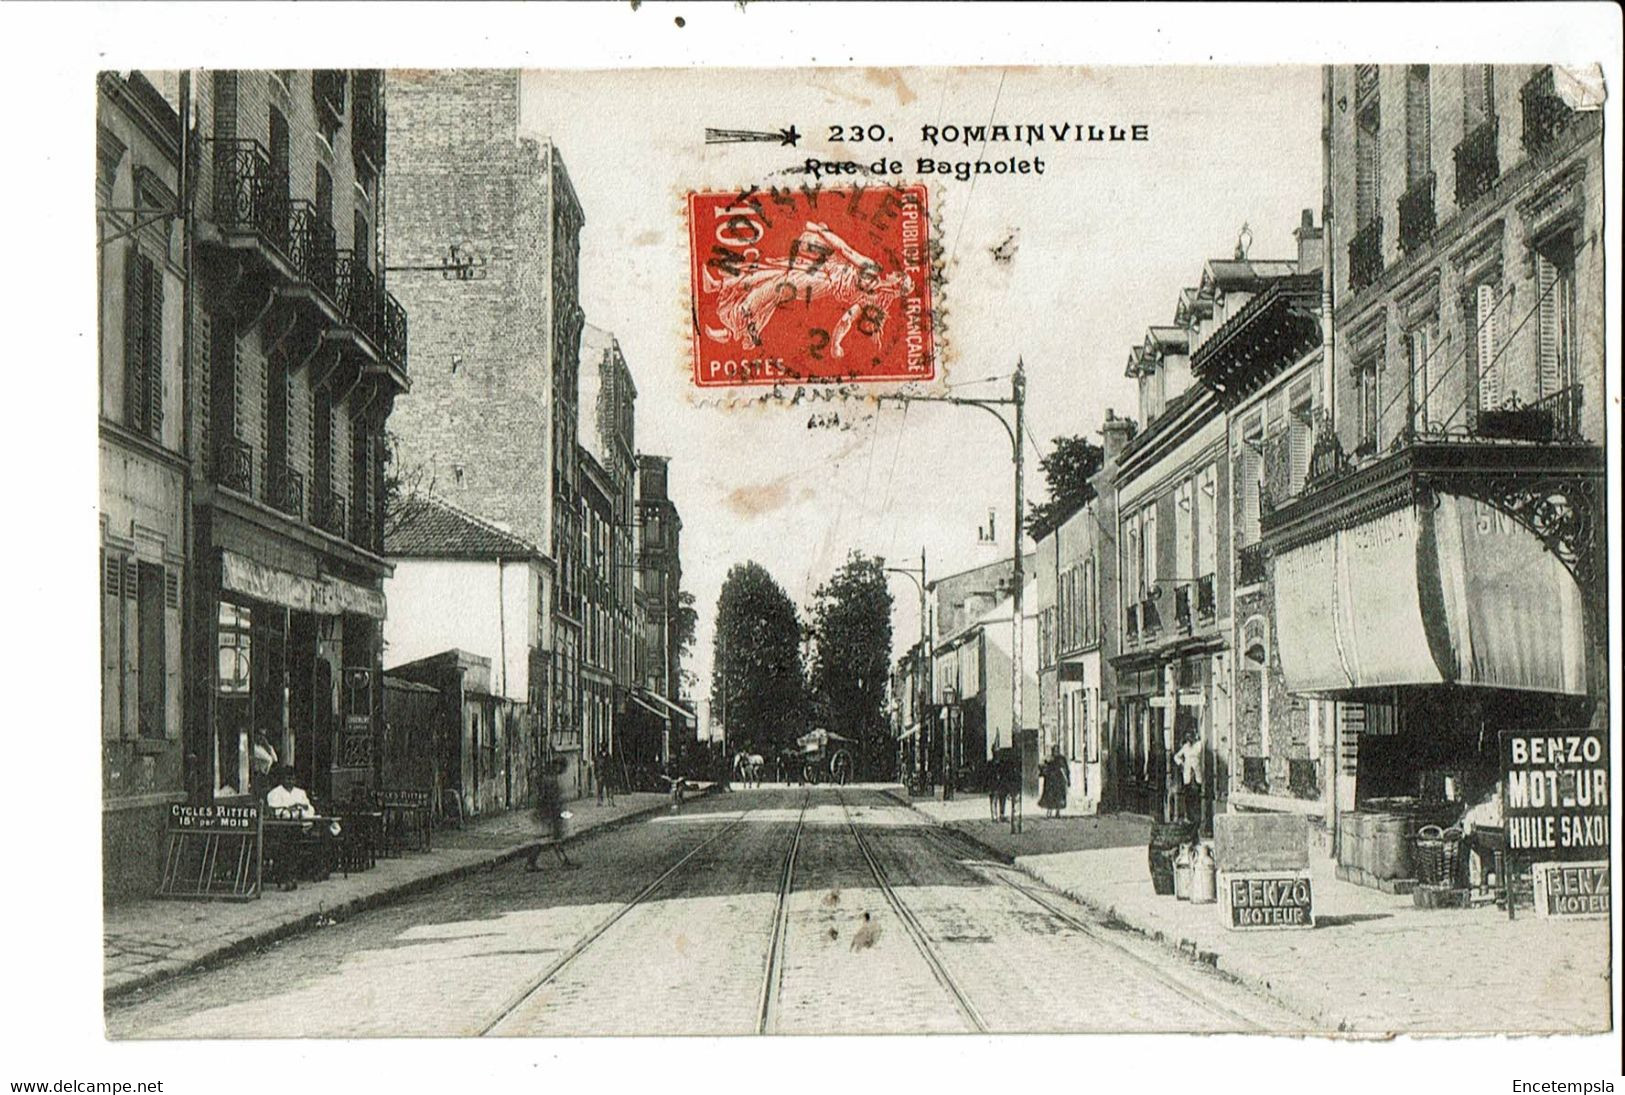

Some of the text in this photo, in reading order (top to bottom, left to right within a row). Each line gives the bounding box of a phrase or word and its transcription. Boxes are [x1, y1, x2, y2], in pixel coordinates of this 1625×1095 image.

[828, 123, 1150, 147] 230. ROMAINVILLE
[804, 156, 1046, 182] Rue de Bagnolet
[709, 359, 786, 378] POSTES
[1511, 736, 1602, 765] BENZO
[171, 804, 257, 818] CYCLES RITTER
[1509, 815, 1556, 849] HUILE
[1232, 880, 1310, 908] BENZO
[1240, 907, 1304, 925] MOTEUR
